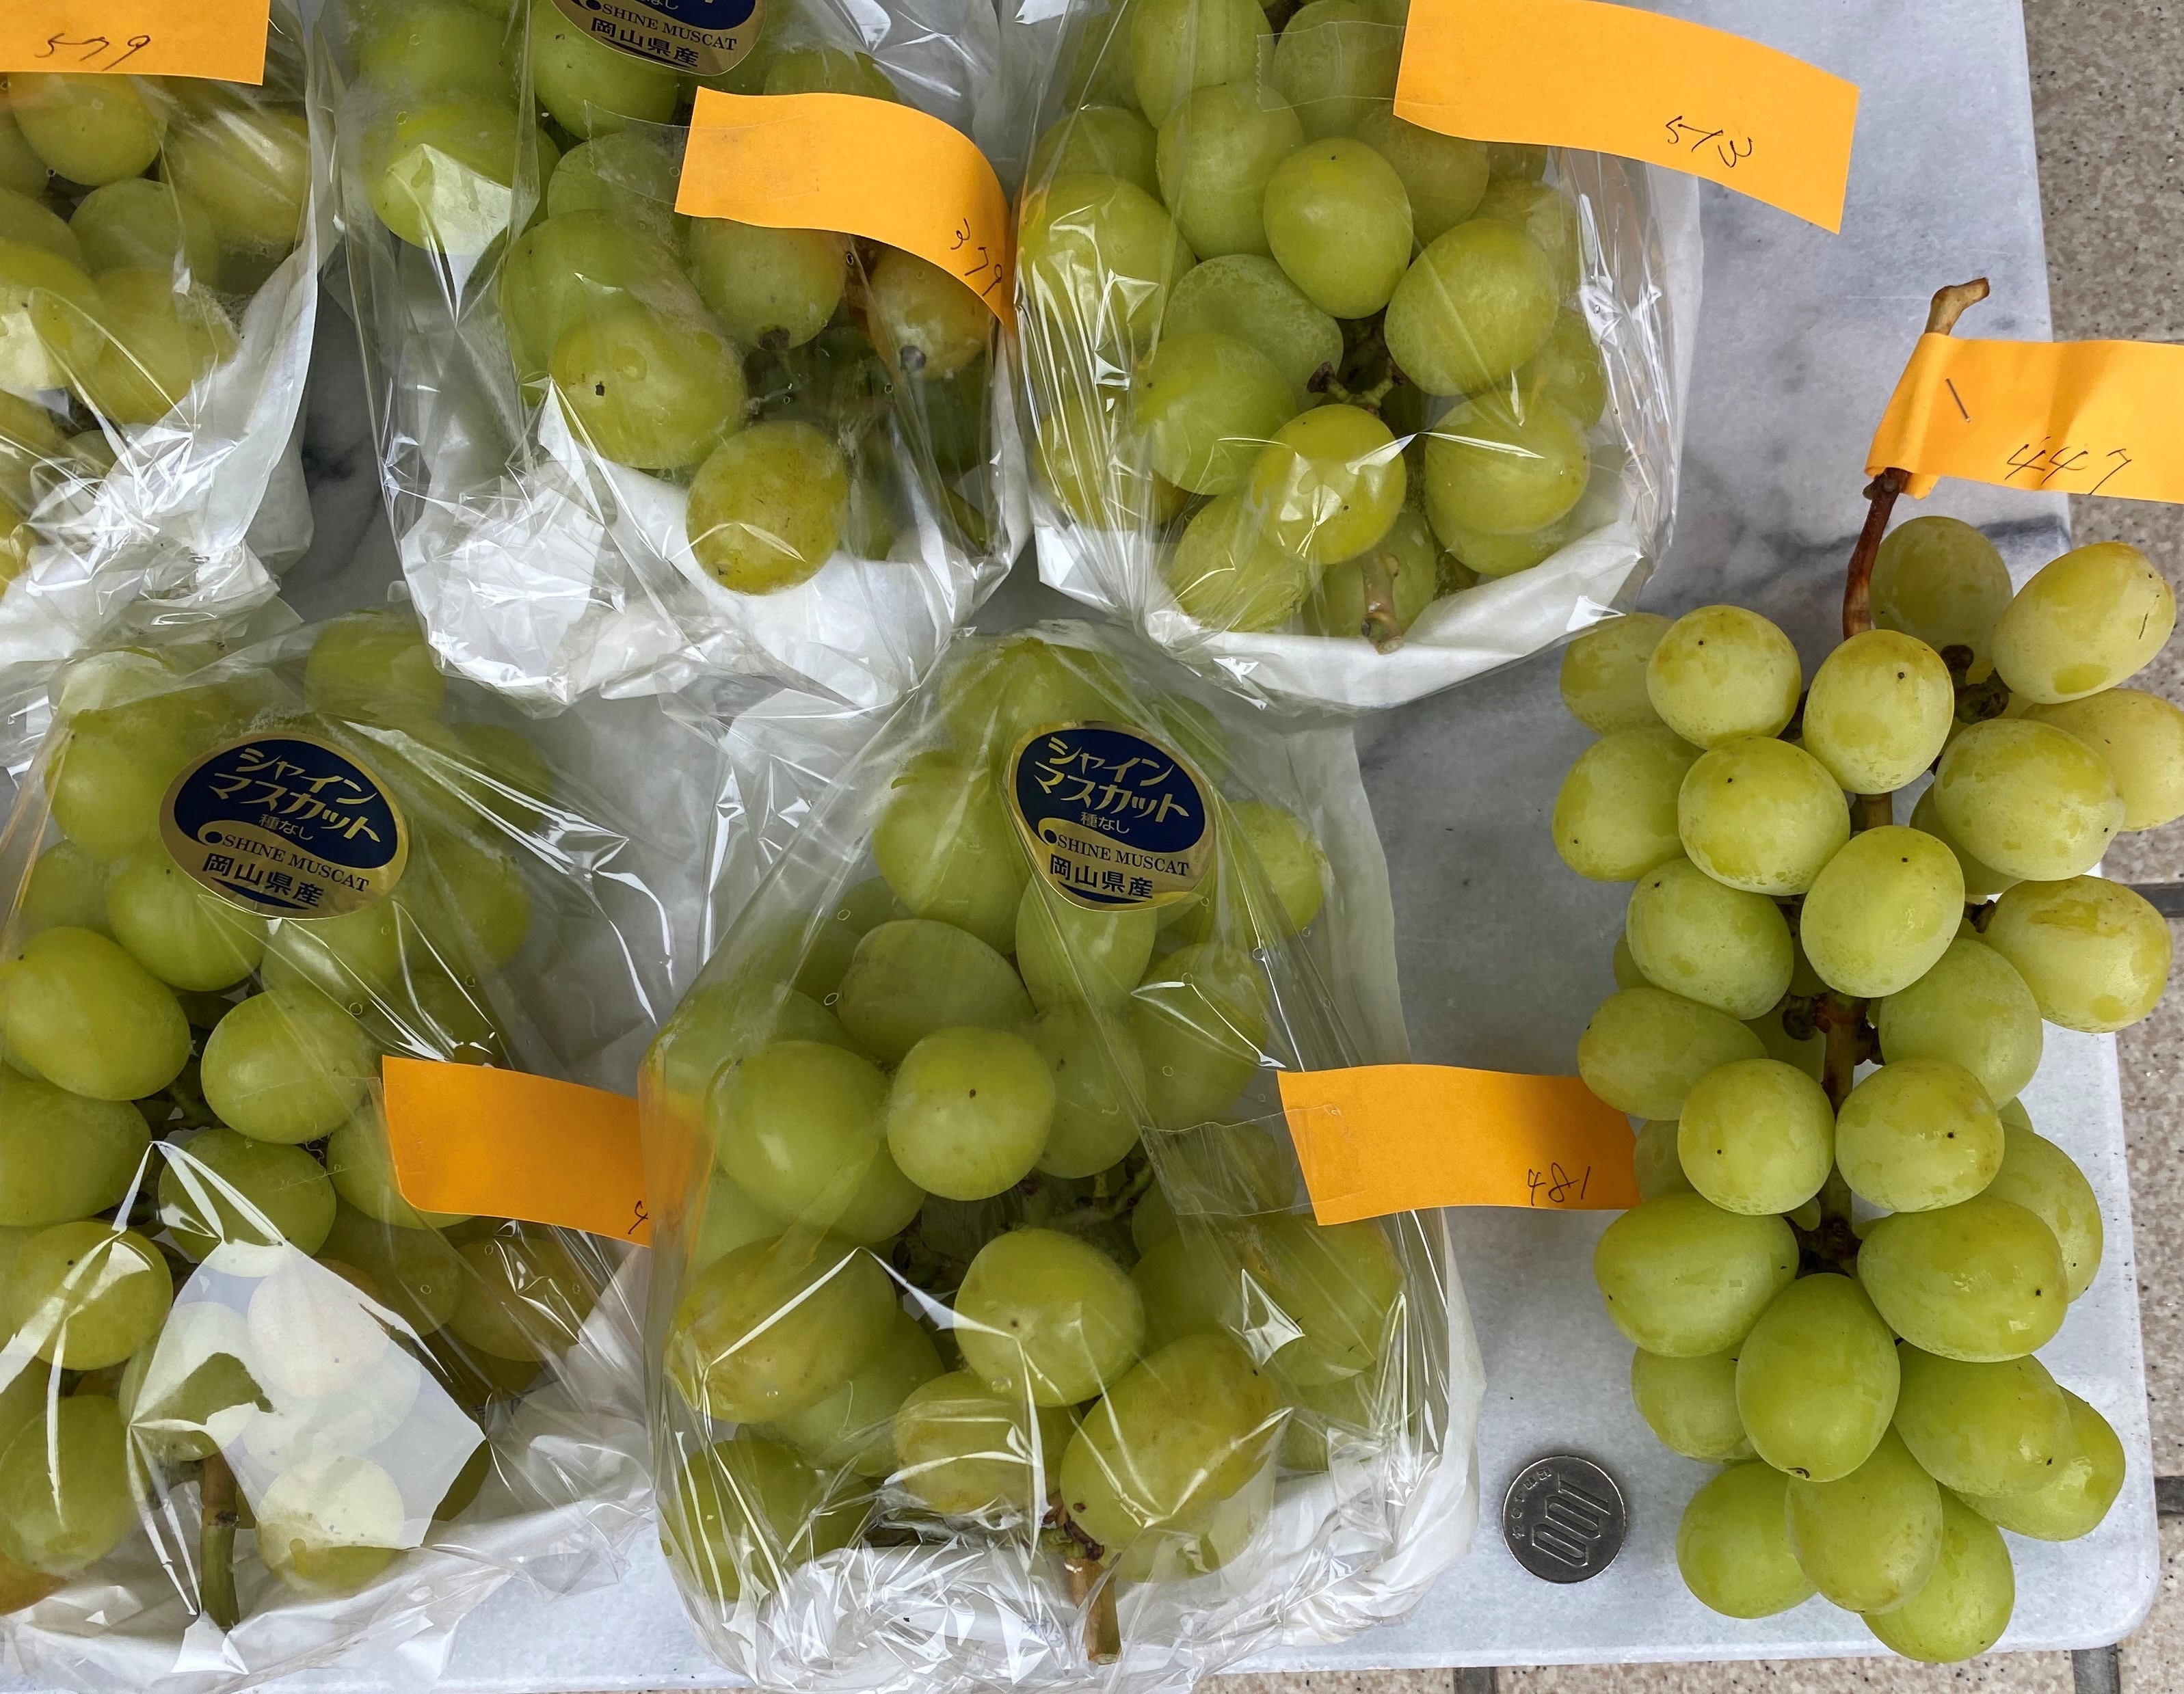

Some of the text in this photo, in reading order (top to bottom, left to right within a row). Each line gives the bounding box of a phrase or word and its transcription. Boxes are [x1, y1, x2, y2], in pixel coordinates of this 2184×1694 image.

[591, 17, 699, 68] 岡山県産
[602, 4, 738, 51] SHINE MUSCAT
[235, 747, 377, 805] シャイン
[1048, 736, 1175, 787] シャイン
[209, 772, 382, 843] マスカット
[1033, 760, 1190, 823] マスカット
[258, 814, 314, 841] 種なし
[1080, 811, 1130, 835] 種なし
[202, 852, 325, 908] 岡山県産
[221, 835, 371, 893] SHINE MUSCAT
[1050, 853, 1154, 899] 岡山県産
[1057, 834, 1189, 877] SHINE MUSCAT
[1527, 1162, 1592, 1207] 481
[1529, 1471, 1612, 1568] 100
